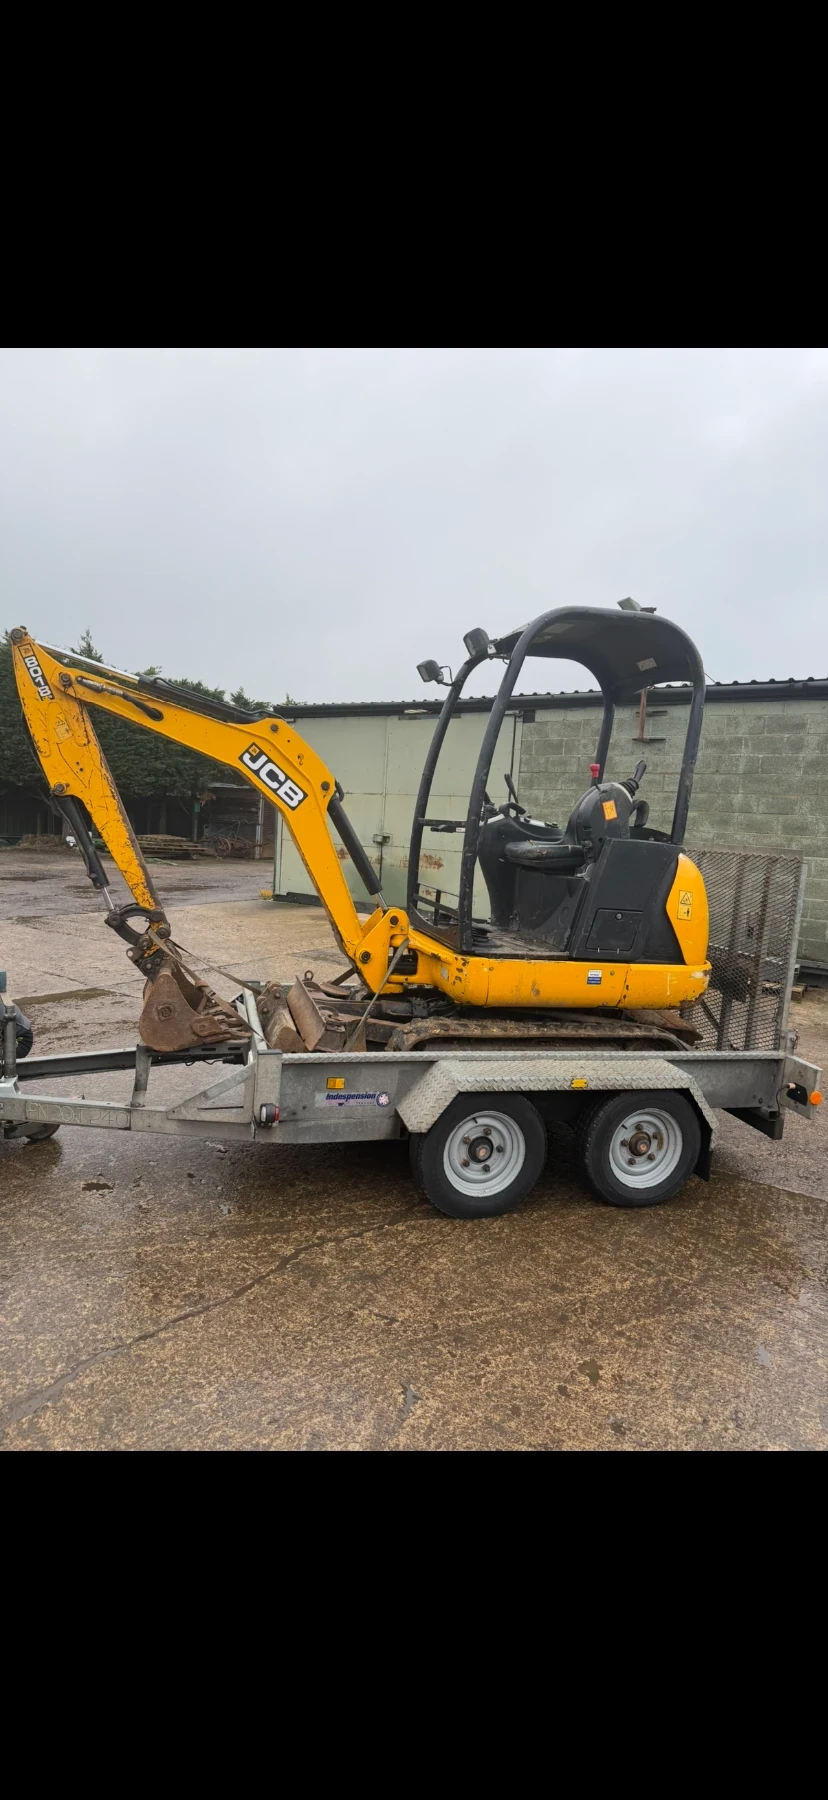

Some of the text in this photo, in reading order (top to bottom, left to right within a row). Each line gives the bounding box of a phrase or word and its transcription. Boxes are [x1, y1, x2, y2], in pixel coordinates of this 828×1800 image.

[24, 655, 52, 698] 8018
[242, 752, 304, 808] JCB
[325, 1092, 376, 1102] Indespension
